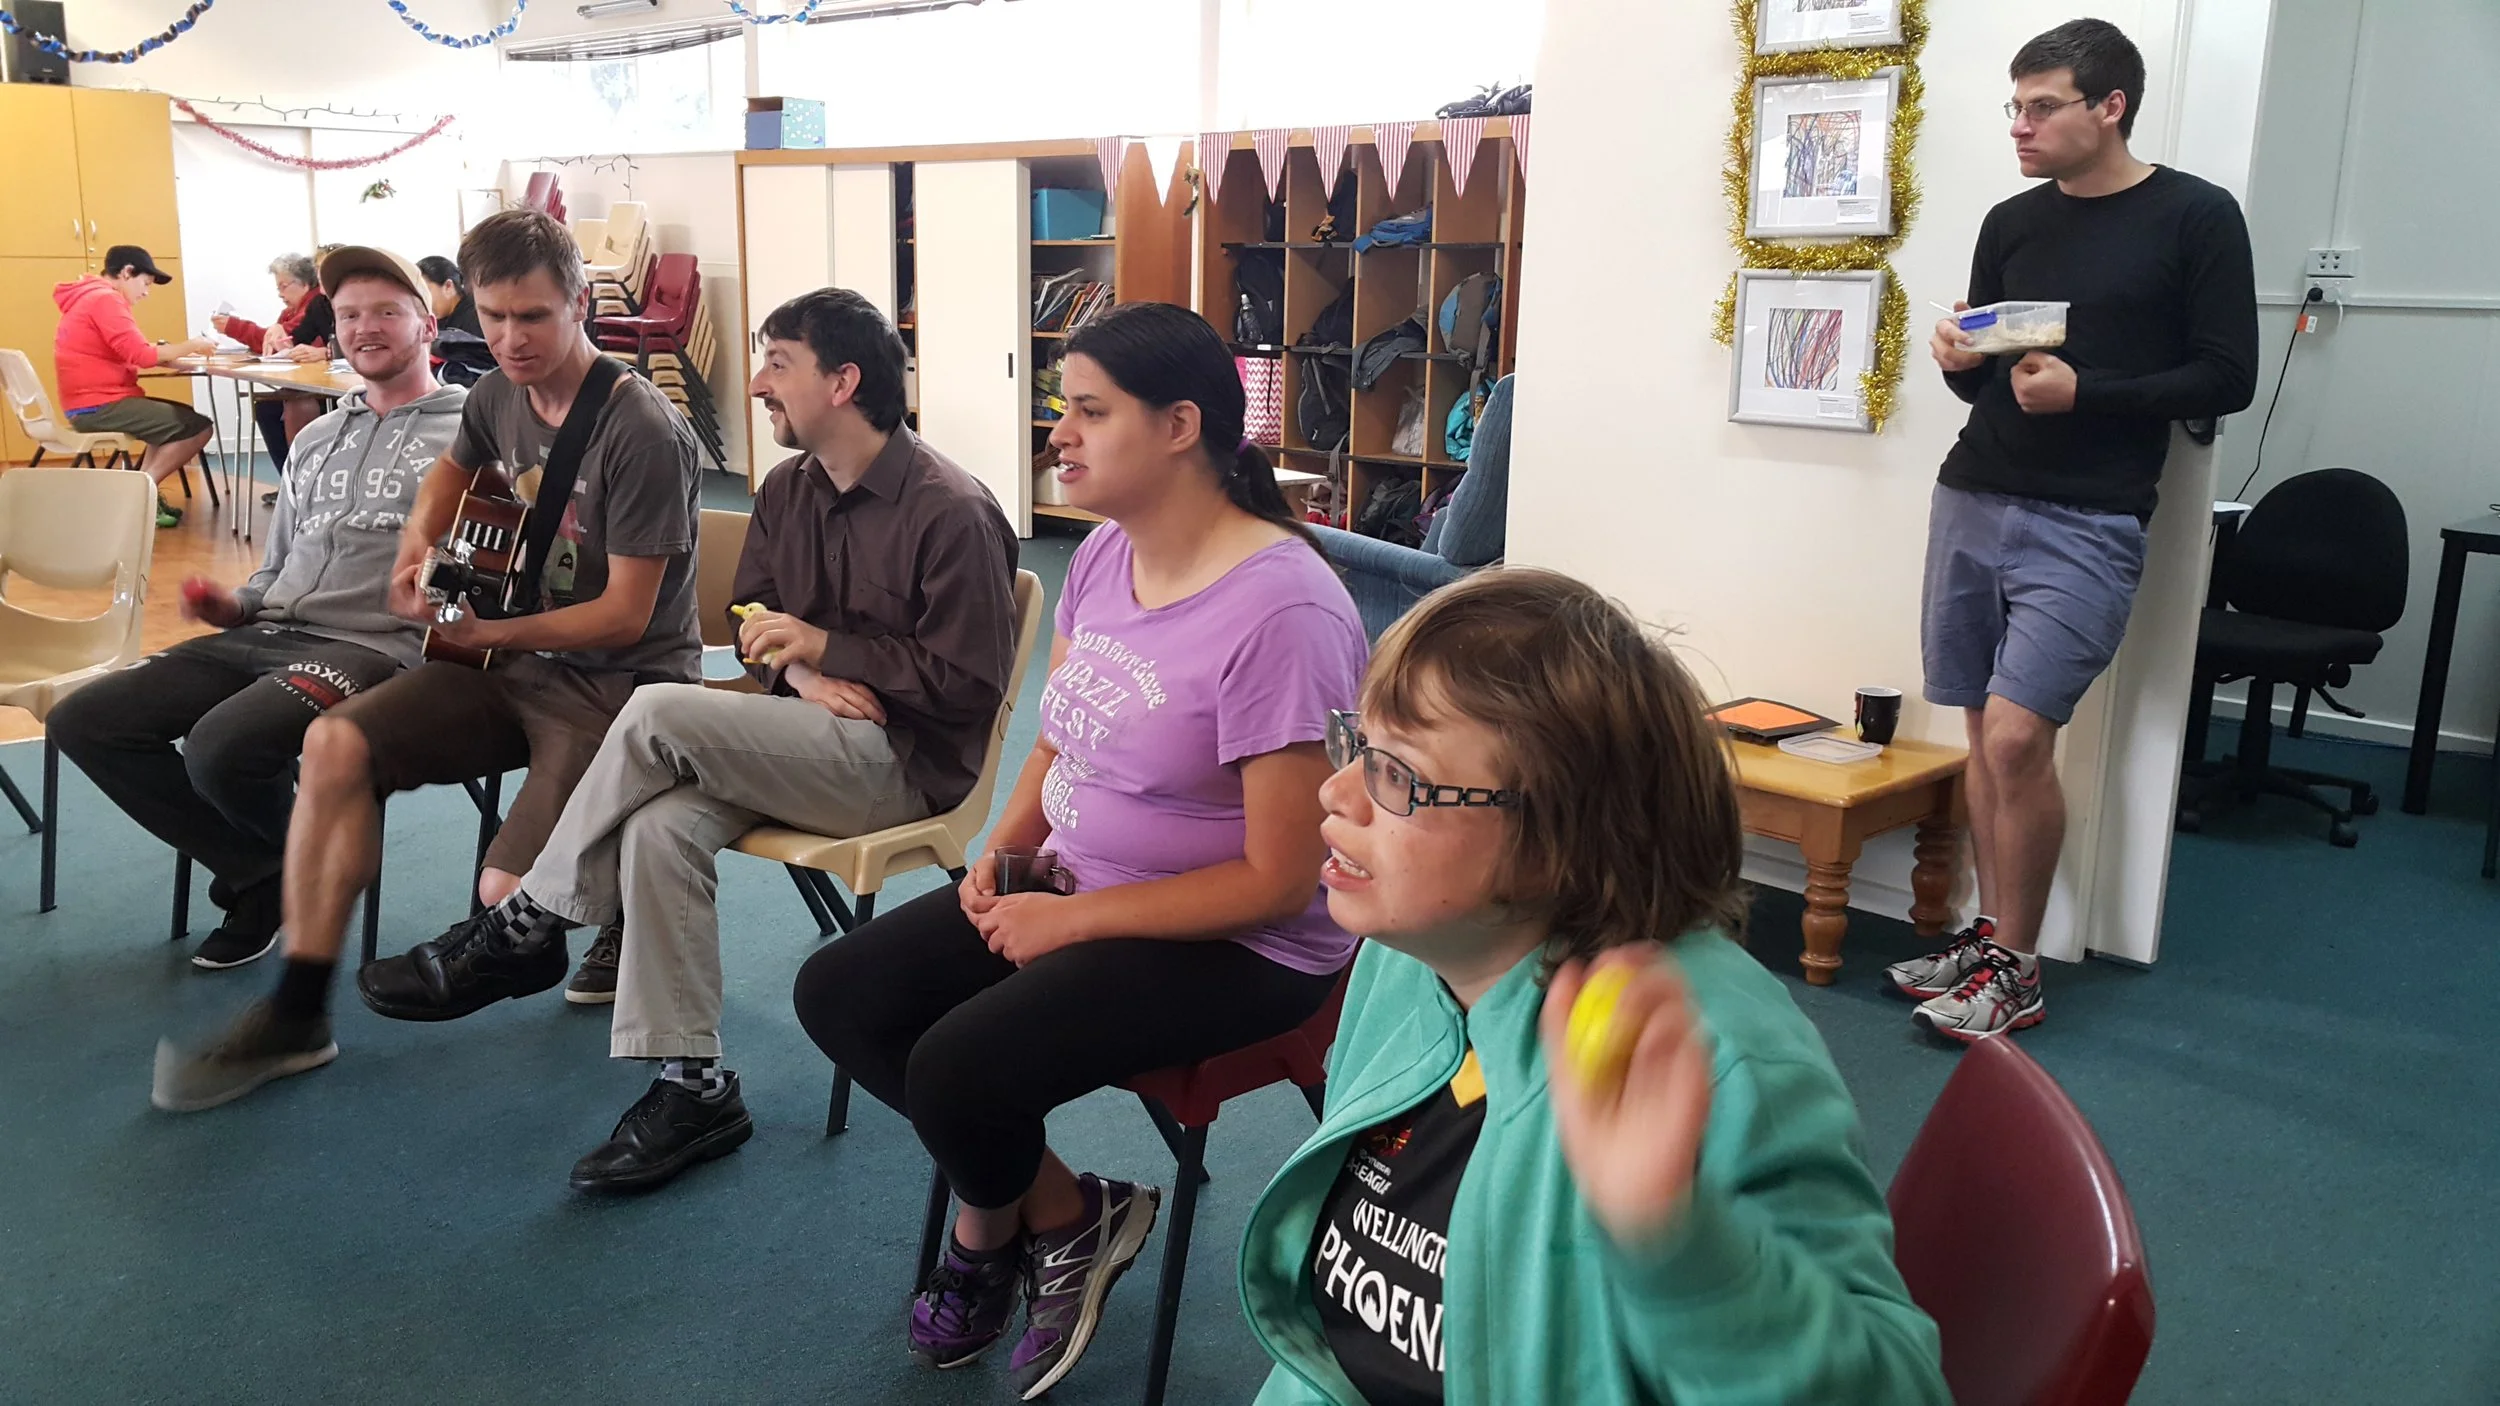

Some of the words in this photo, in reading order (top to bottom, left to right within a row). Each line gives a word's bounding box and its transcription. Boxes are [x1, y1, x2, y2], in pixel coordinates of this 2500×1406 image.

[385, 428, 436, 484] TEA
[288, 663, 357, 697] BOXIN
[301, 696, 326, 715] LOND
[1352, 1197, 1449, 1280] WELLINGT
[1314, 1219, 1446, 1373] PHOEN
